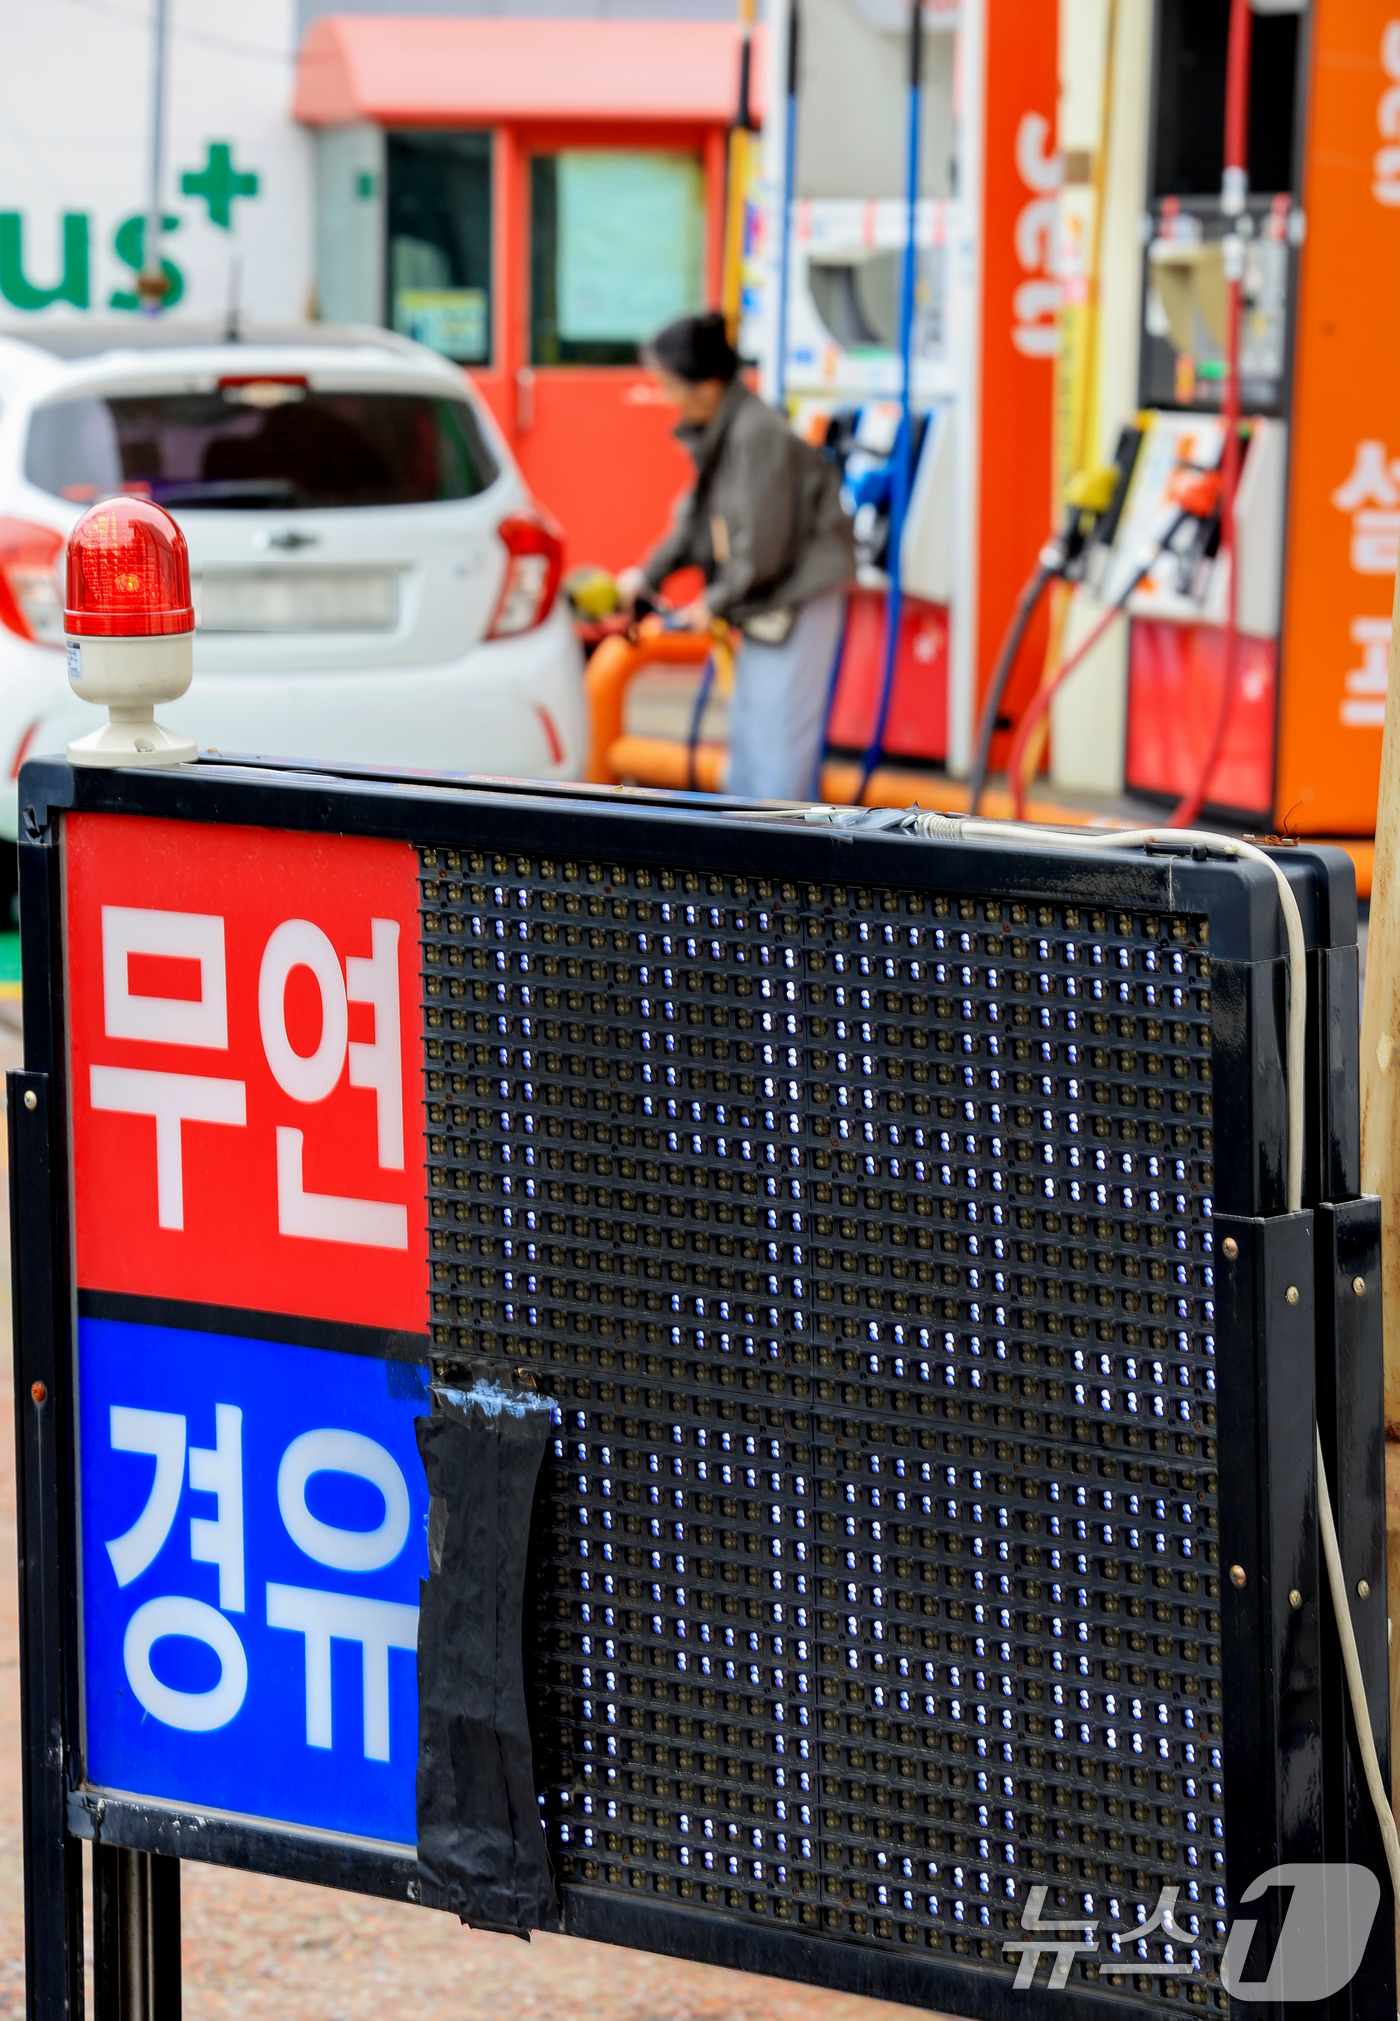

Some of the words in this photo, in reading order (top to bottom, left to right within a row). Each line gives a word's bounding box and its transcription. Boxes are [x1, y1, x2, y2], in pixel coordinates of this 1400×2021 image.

[89, 905, 409, 1251] 무연
[472, 886, 1217, 1424] 1995
[103, 1402, 419, 1763] 경유
